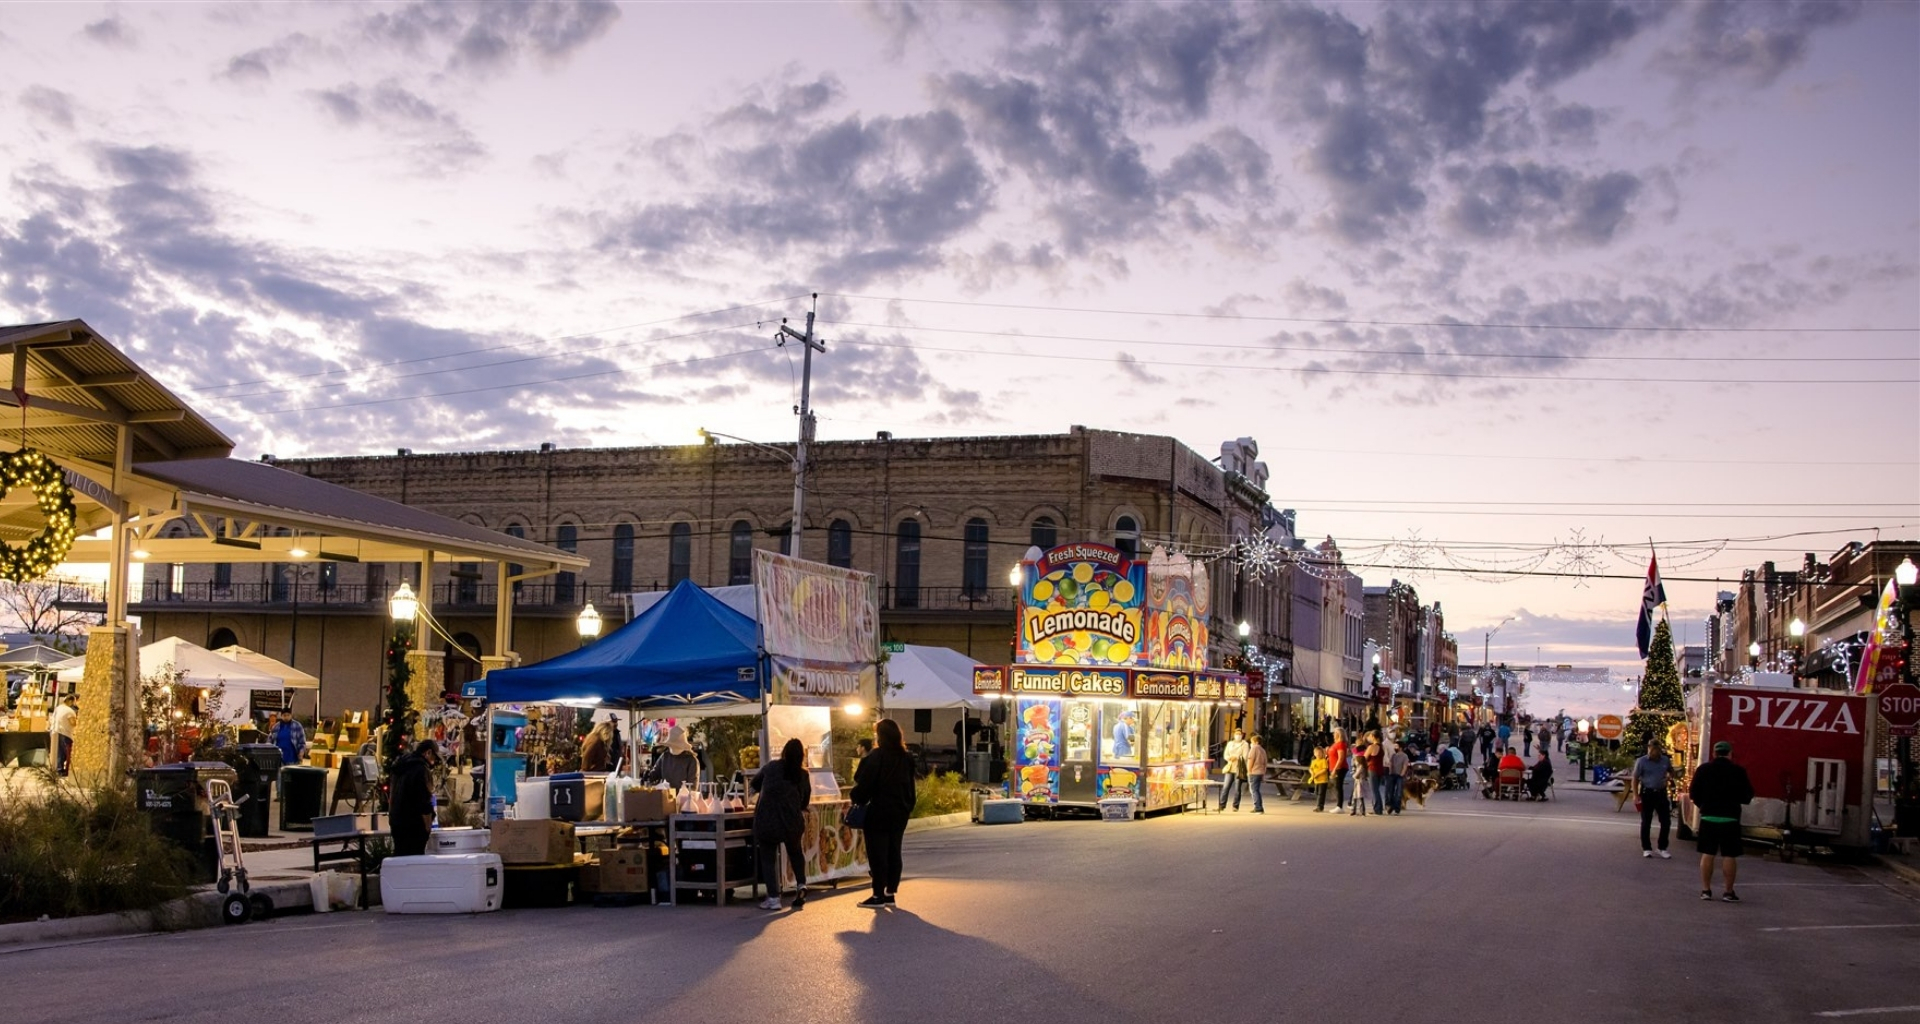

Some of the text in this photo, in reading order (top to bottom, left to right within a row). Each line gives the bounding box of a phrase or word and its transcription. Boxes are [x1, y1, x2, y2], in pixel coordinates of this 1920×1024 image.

[1048, 546, 1120, 563] Fresh Squeezed
[1031, 611, 1135, 643] Lemonade
[788, 669, 860, 693] LEMONADE
[975, 677, 1002, 690] Lemonade
[1013, 671, 1125, 693] Funnel Cakes
[1136, 679, 1190, 696] Lemonade
[1727, 694, 1860, 734] PIZZA
[1881, 697, 1920, 713] STOP
